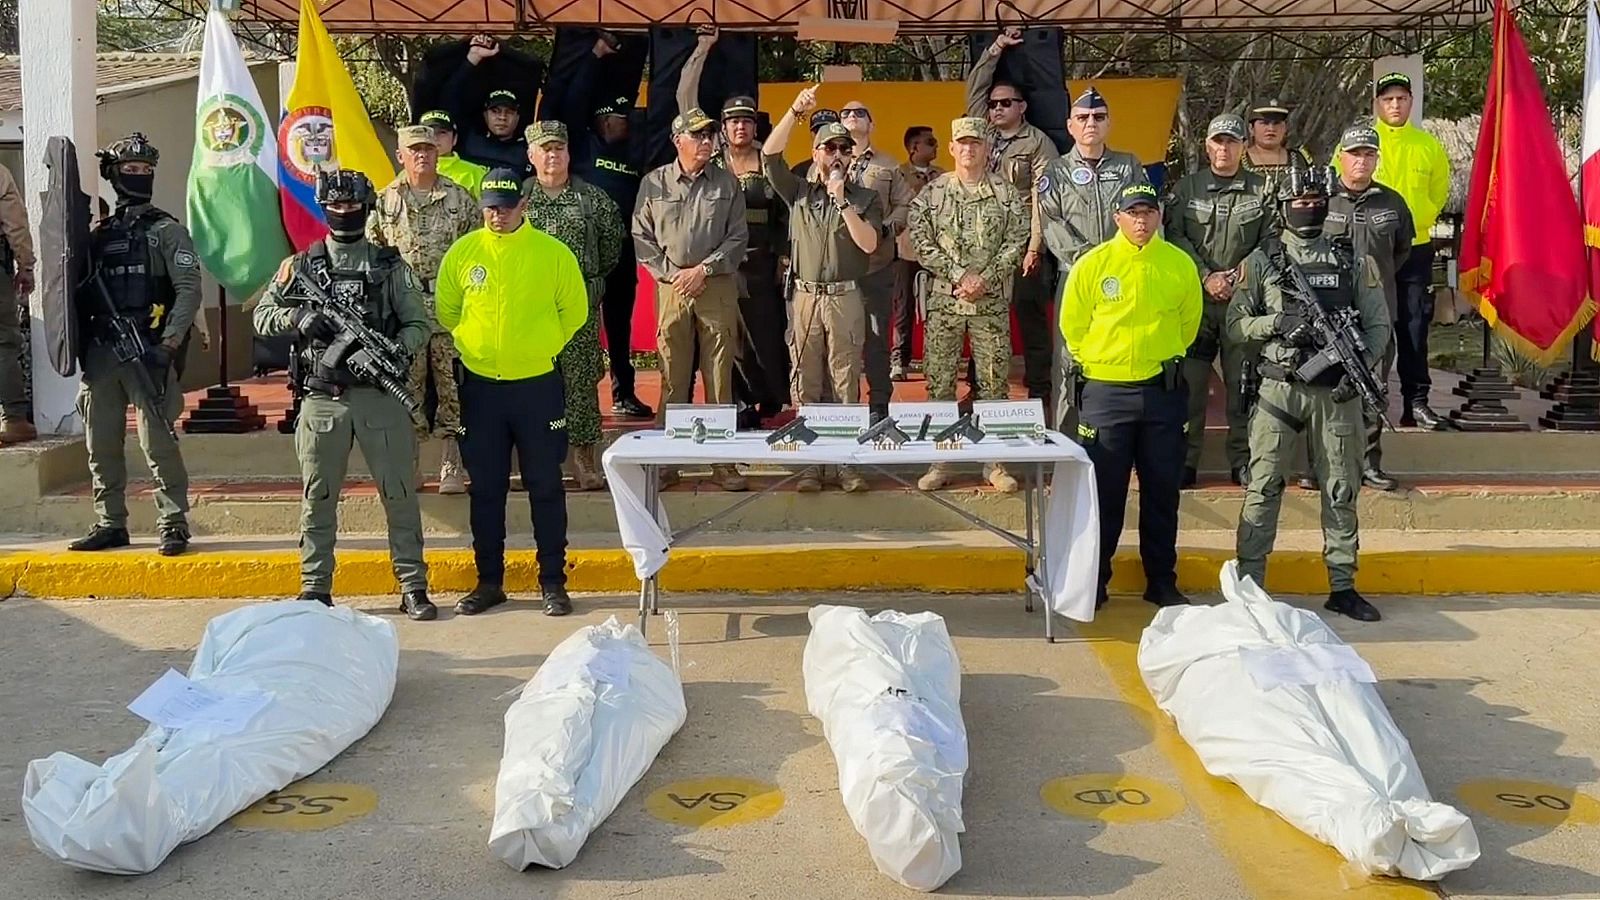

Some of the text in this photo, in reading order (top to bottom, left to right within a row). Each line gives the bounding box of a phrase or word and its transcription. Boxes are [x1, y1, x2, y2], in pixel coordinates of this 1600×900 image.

[594, 158, 639, 176] POLIC
[481, 179, 518, 191] POLICÍA
[981, 408, 1036, 418] CELULARES
